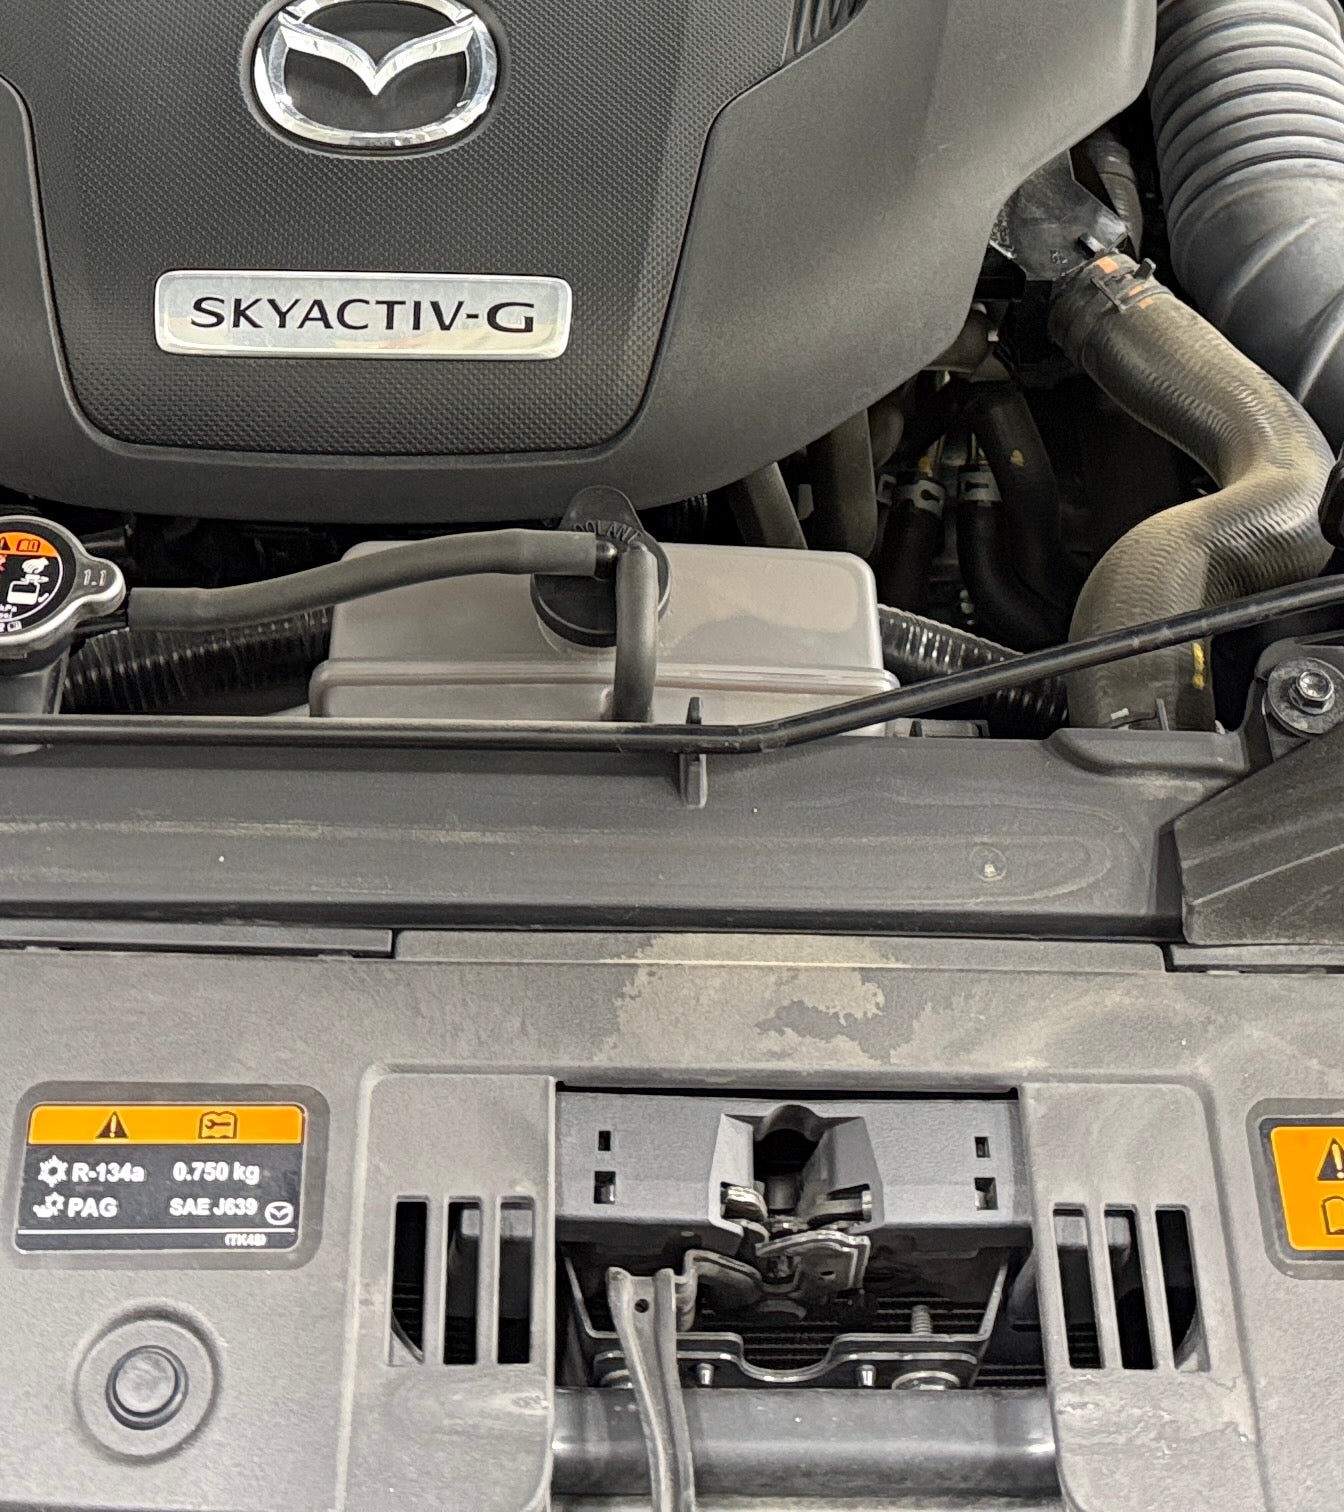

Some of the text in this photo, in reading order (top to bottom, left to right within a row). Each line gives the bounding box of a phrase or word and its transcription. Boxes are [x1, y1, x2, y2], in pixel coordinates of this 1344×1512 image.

[190, 297, 535, 334] SKYACTIV-G
[71, 1161, 260, 1185] R-134a 0.750 kg
[67, 1197, 258, 1217] PAG SAE J639
